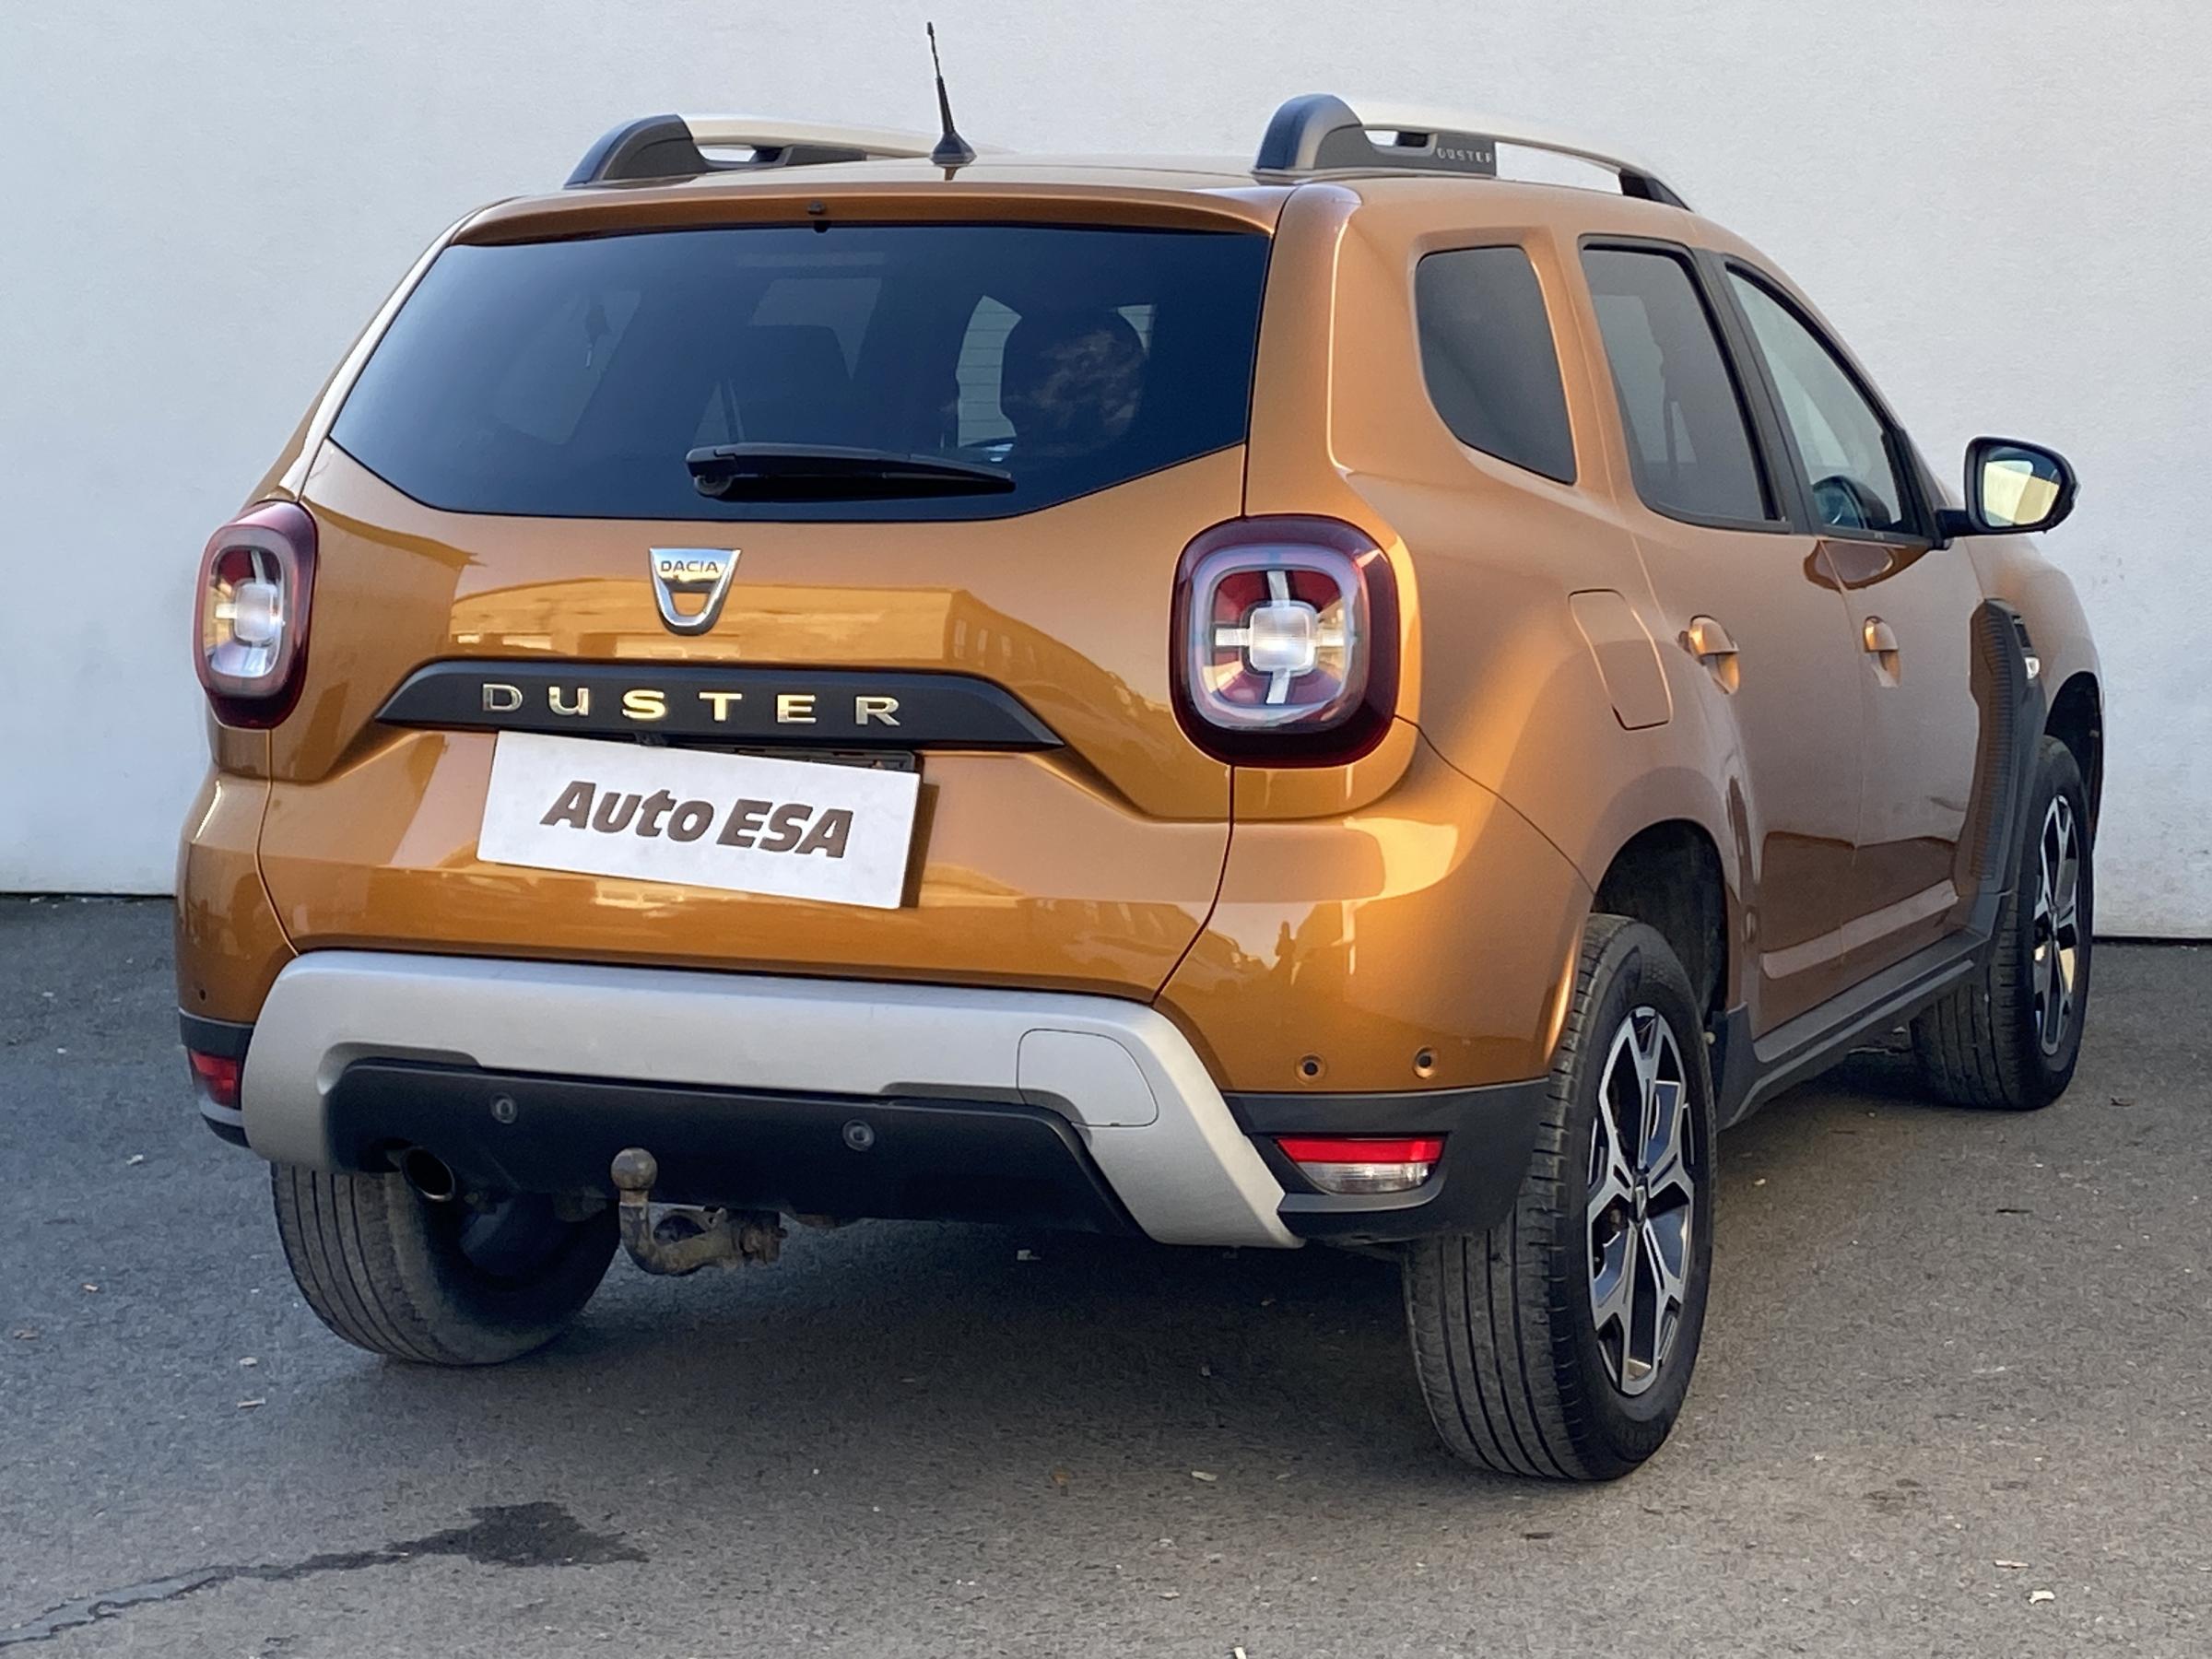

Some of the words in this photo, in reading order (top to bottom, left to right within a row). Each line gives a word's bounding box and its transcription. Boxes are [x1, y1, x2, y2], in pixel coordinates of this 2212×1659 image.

[661, 560, 719, 572] DACIA
[482, 684, 900, 726] DUSTER
[540, 781, 714, 841] Auto
[717, 799, 853, 858] ESA
